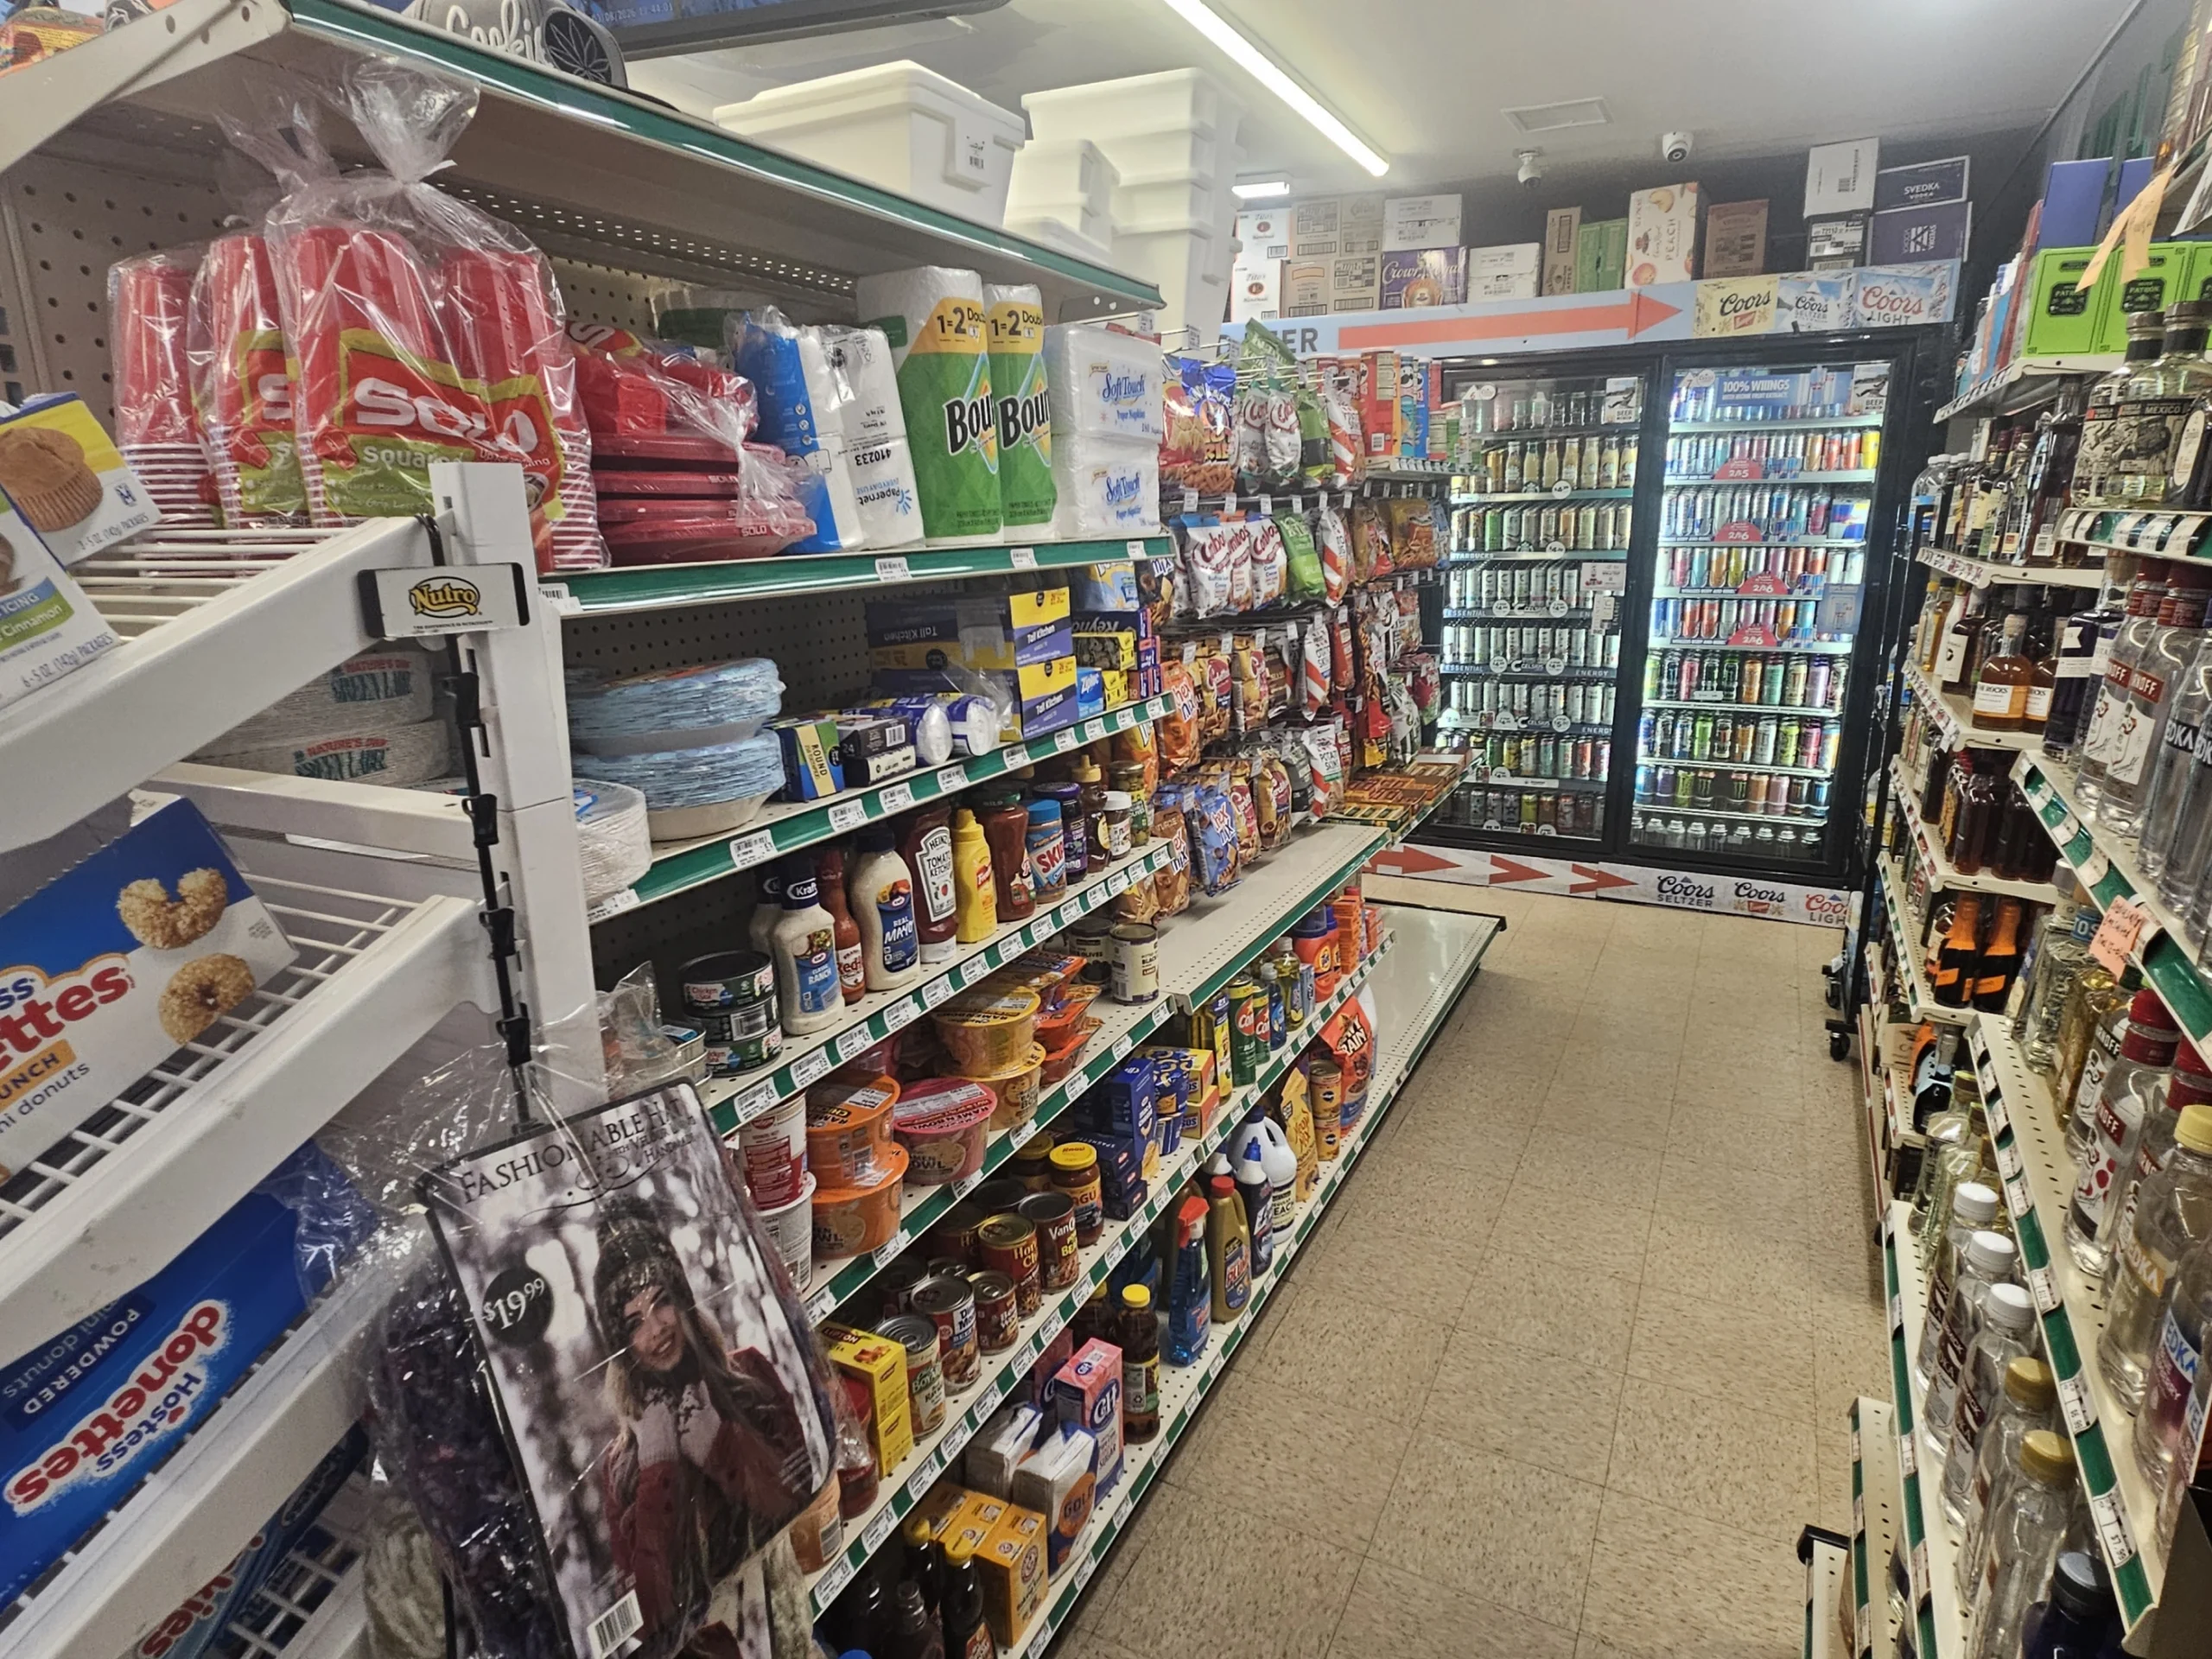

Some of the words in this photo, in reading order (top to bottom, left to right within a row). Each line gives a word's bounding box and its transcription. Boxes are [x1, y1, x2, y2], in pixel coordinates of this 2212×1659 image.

[1904, 181, 1940, 195] SVEDKA
[1666, 218, 1678, 261] PEACH
[1719, 290, 1771, 316] Coors
[1795, 296, 1828, 313] Coors
[1862, 286, 1923, 315] Coors
[1870, 310, 1910, 325] LIGHT
[1722, 380, 1750, 392] 100%
[2145, 405, 2182, 415] MEXICO
[855, 448, 892, 467] 410233
[856, 487, 901, 506] Papernet
[741, 524, 767, 537] SOLO
[1451, 551, 1495, 560] STARBUCKS
[408, 581, 480, 616] Nutro
[3, 604, 63, 639] Cinnamon
[1071, 616, 1120, 635] Reyno
[884, 628, 918, 641] Kitchen
[918, 626, 938, 638] Tall
[1027, 632, 1036, 644] Tall
[1036, 623, 1056, 640] Kitchen
[1036, 702, 1045, 715] Tall
[1044, 693, 1065, 711] Kitchen
[842, 743, 855, 754] 24
[810, 743, 828, 777] ROUND
[1657, 875, 1714, 899] Coors
[1734, 881, 1787, 903] Coors
[1657, 893, 1713, 908] SELTZER
[893, 916, 909, 927] REAL
[1809, 912, 1846, 925] LIGH
[884, 921, 914, 944] MAYO
[836, 959, 864, 975] Red
[807, 969, 832, 986] RANCH
[17, 1062, 91, 1117] donuts
[909, 1160, 944, 1170] OWL
[3, 1332, 79, 1398] donuts
[23, 1307, 141, 1415] POWDERED
[14, 1305, 222, 1505] donettes
[96, 1371, 203, 1472] Hostess
